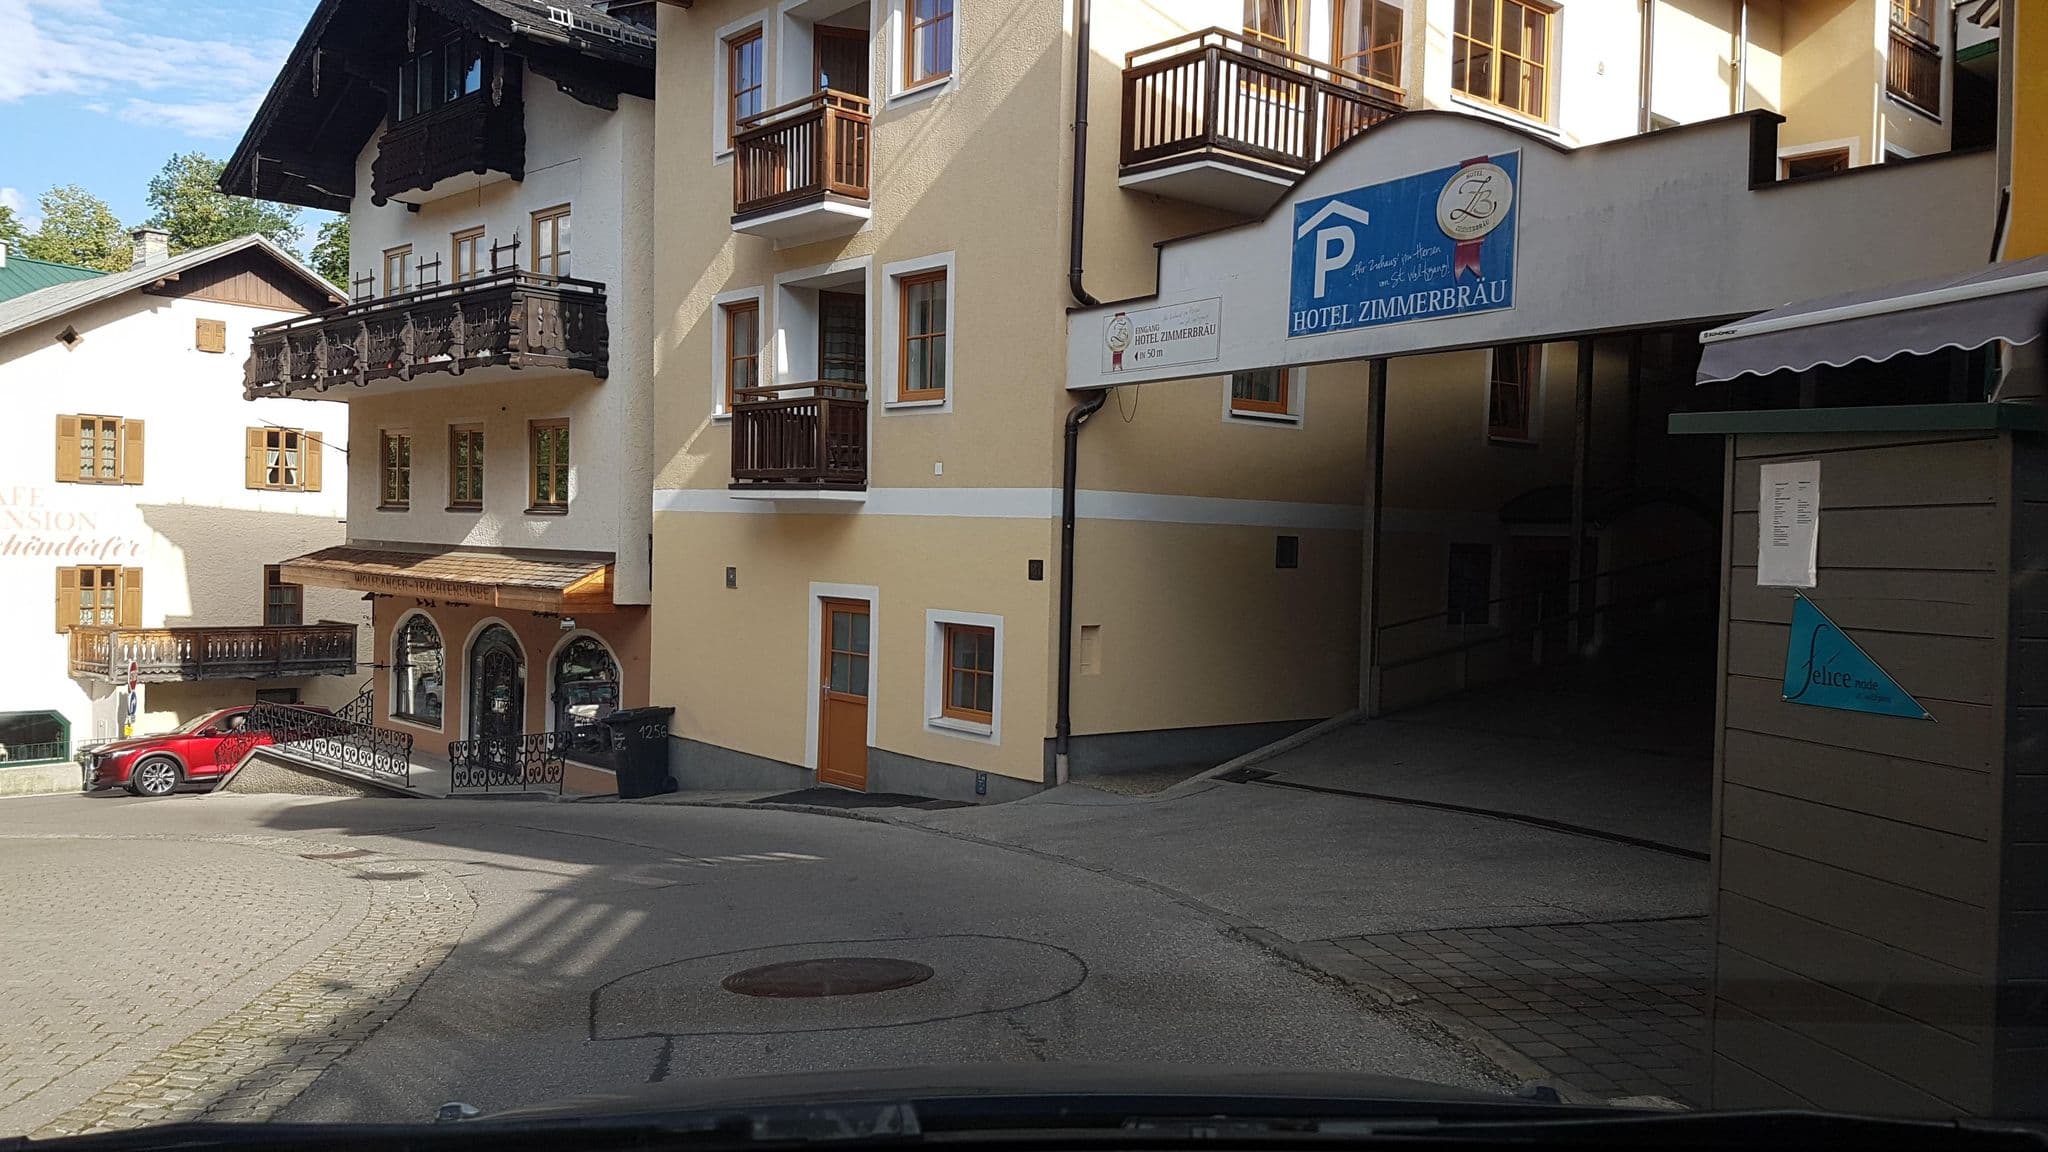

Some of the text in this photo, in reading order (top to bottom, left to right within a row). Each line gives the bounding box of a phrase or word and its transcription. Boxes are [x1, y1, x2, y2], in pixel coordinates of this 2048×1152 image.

[1313, 225, 1356, 299] P
[1292, 276, 1508, 333] HOTEL ZIMMERBRÄU
[1135, 324, 1160, 335] EINGANG
[1135, 322, 1217, 346] HOTEL ZIMMERBRÄU
[1147, 348, 1156, 359] 50
[0, 533, 141, 561] höndorfer
[638, 723, 667, 739] 1256
